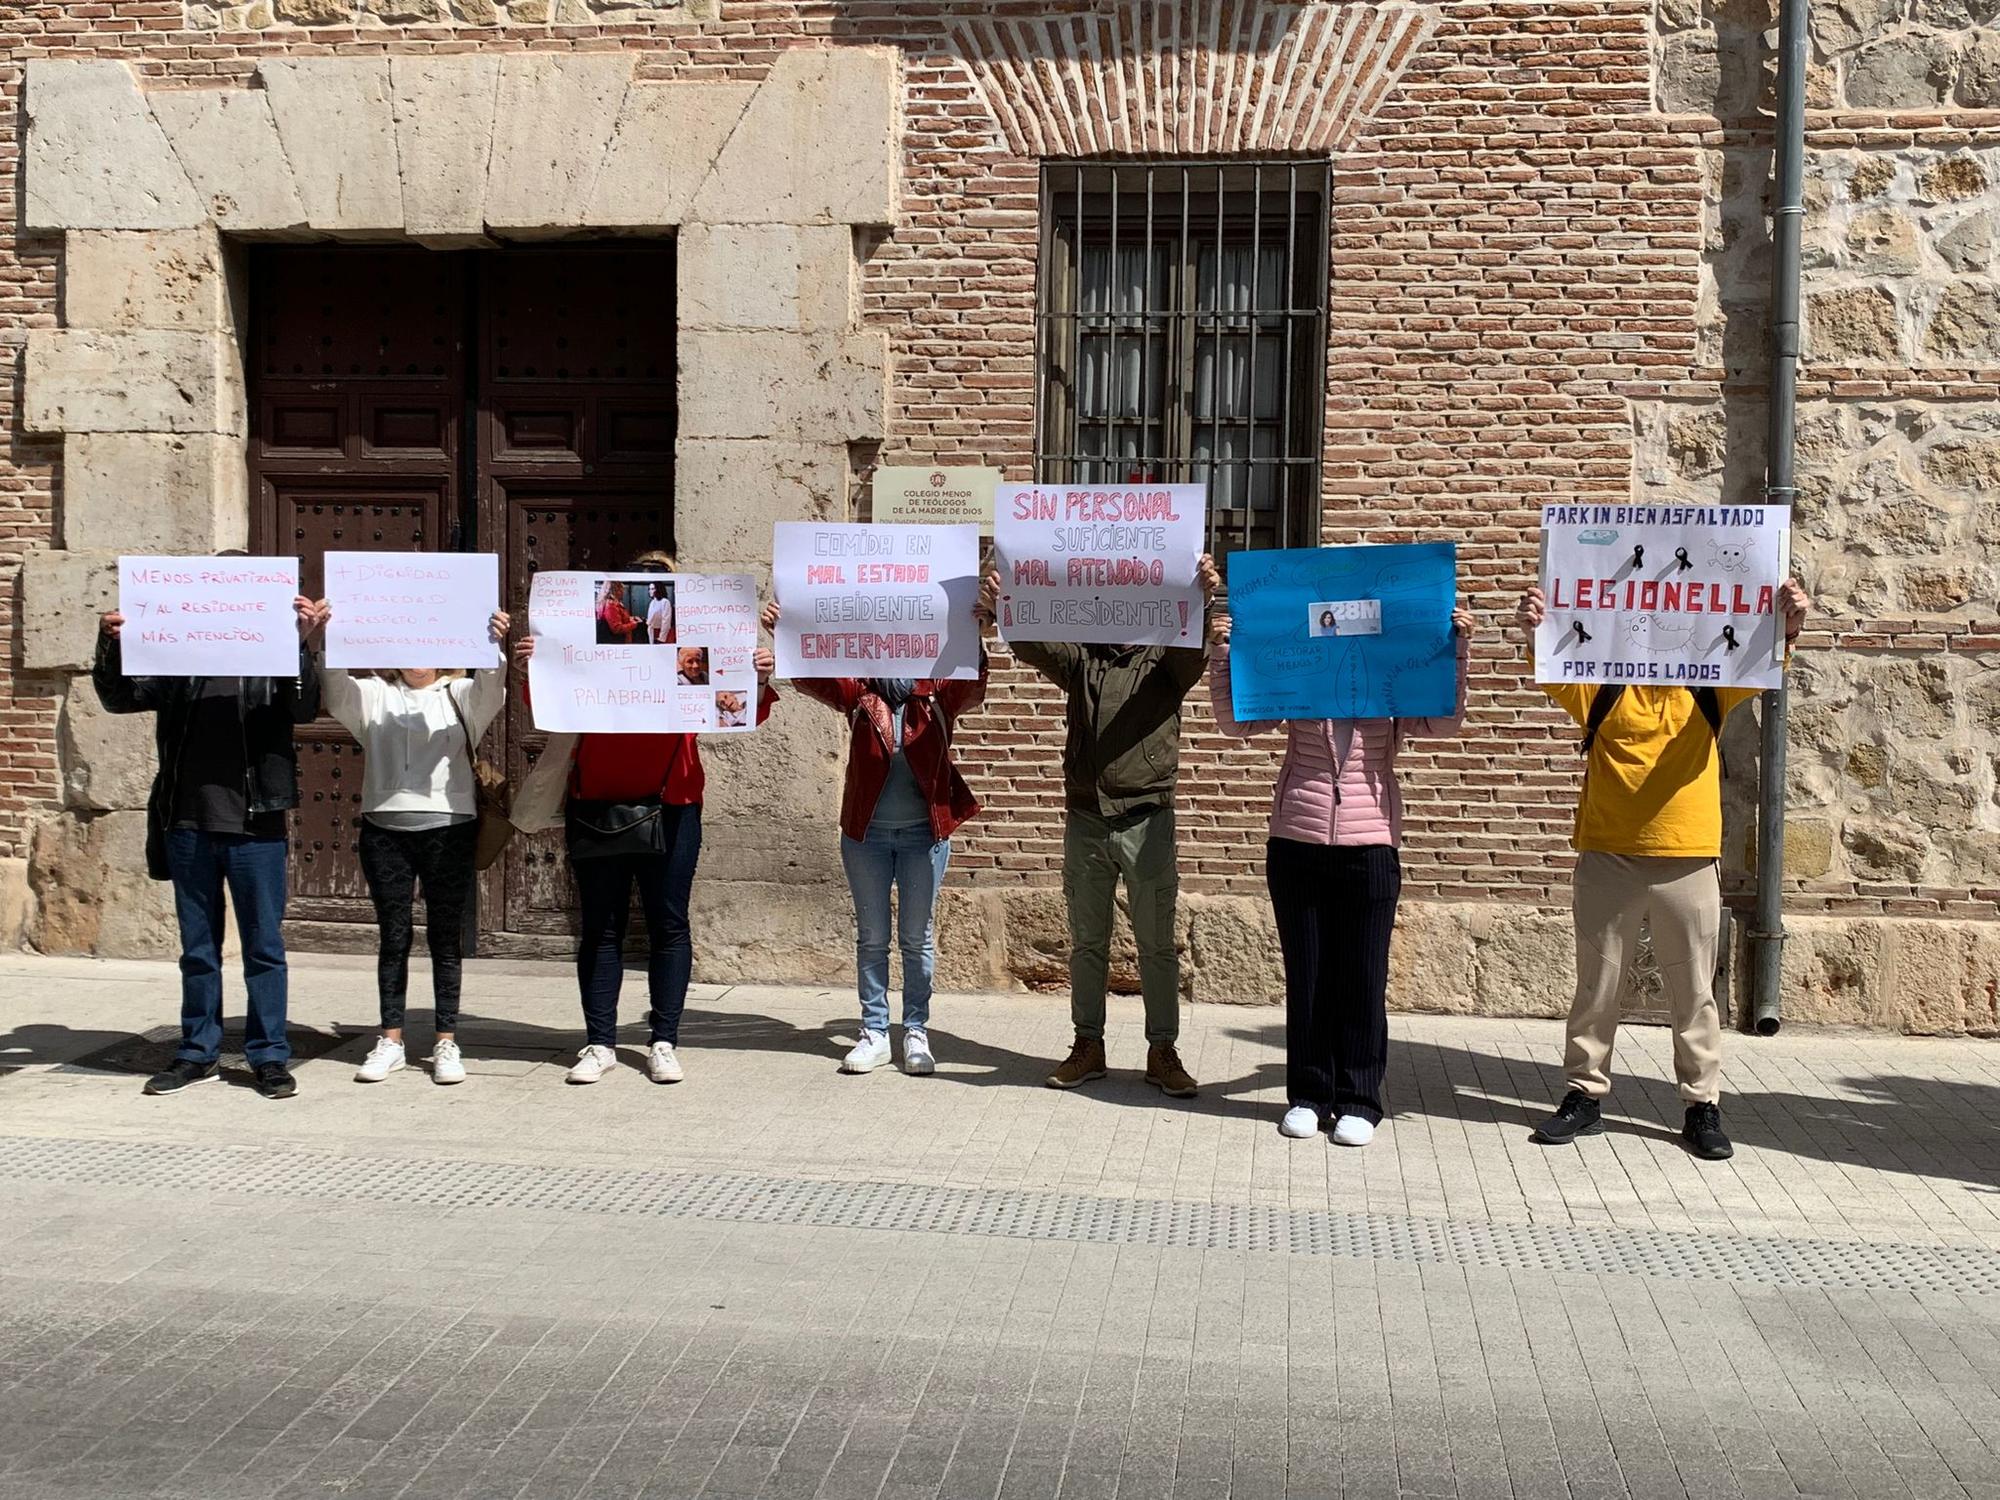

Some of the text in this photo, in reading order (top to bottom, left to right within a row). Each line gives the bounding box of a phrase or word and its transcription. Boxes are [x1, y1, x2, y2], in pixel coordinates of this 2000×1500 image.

[903, 490, 972, 498] COLEGIO MENOR
[923, 498, 967, 506] TEÓLOGOS
[918, 507, 947, 515] MADRE
[1013, 490, 1180, 522] SIN PERSONAL
[1617, 508, 1656, 526] BIEN
[1660, 508, 1765, 527] ASFALTADO
[814, 529, 931, 556] COMIDA EN
[1052, 524, 1166, 552] SUFICIENTE
[132, 568, 193, 585] MENOS
[357, 563, 450, 581] DIGNIDAD
[807, 563, 930, 585] MAL ESTADO
[1014, 556, 1163, 587] MAL ATENDIDO
[555, 577, 578, 587] UNA
[676, 577, 744, 594] LOS HAS
[351, 593, 446, 604] FALSEDAD
[537, 588, 580, 598] COMIDA
[1552, 578, 1774, 615] LEGIONELLA
[135, 599, 267, 618] Y AL RESIDENTE
[676, 604, 751, 617] ABANDONADO
[815, 592, 934, 624] RESIDENTE
[1329, 601, 1379, 621] 28M
[141, 627, 178, 644] MÁS
[677, 624, 726, 639] BASTA
[801, 632, 940, 660] ENFERMADO
[621, 666, 652, 682] TU
[1563, 661, 1721, 680] POR TODOS LADOS
